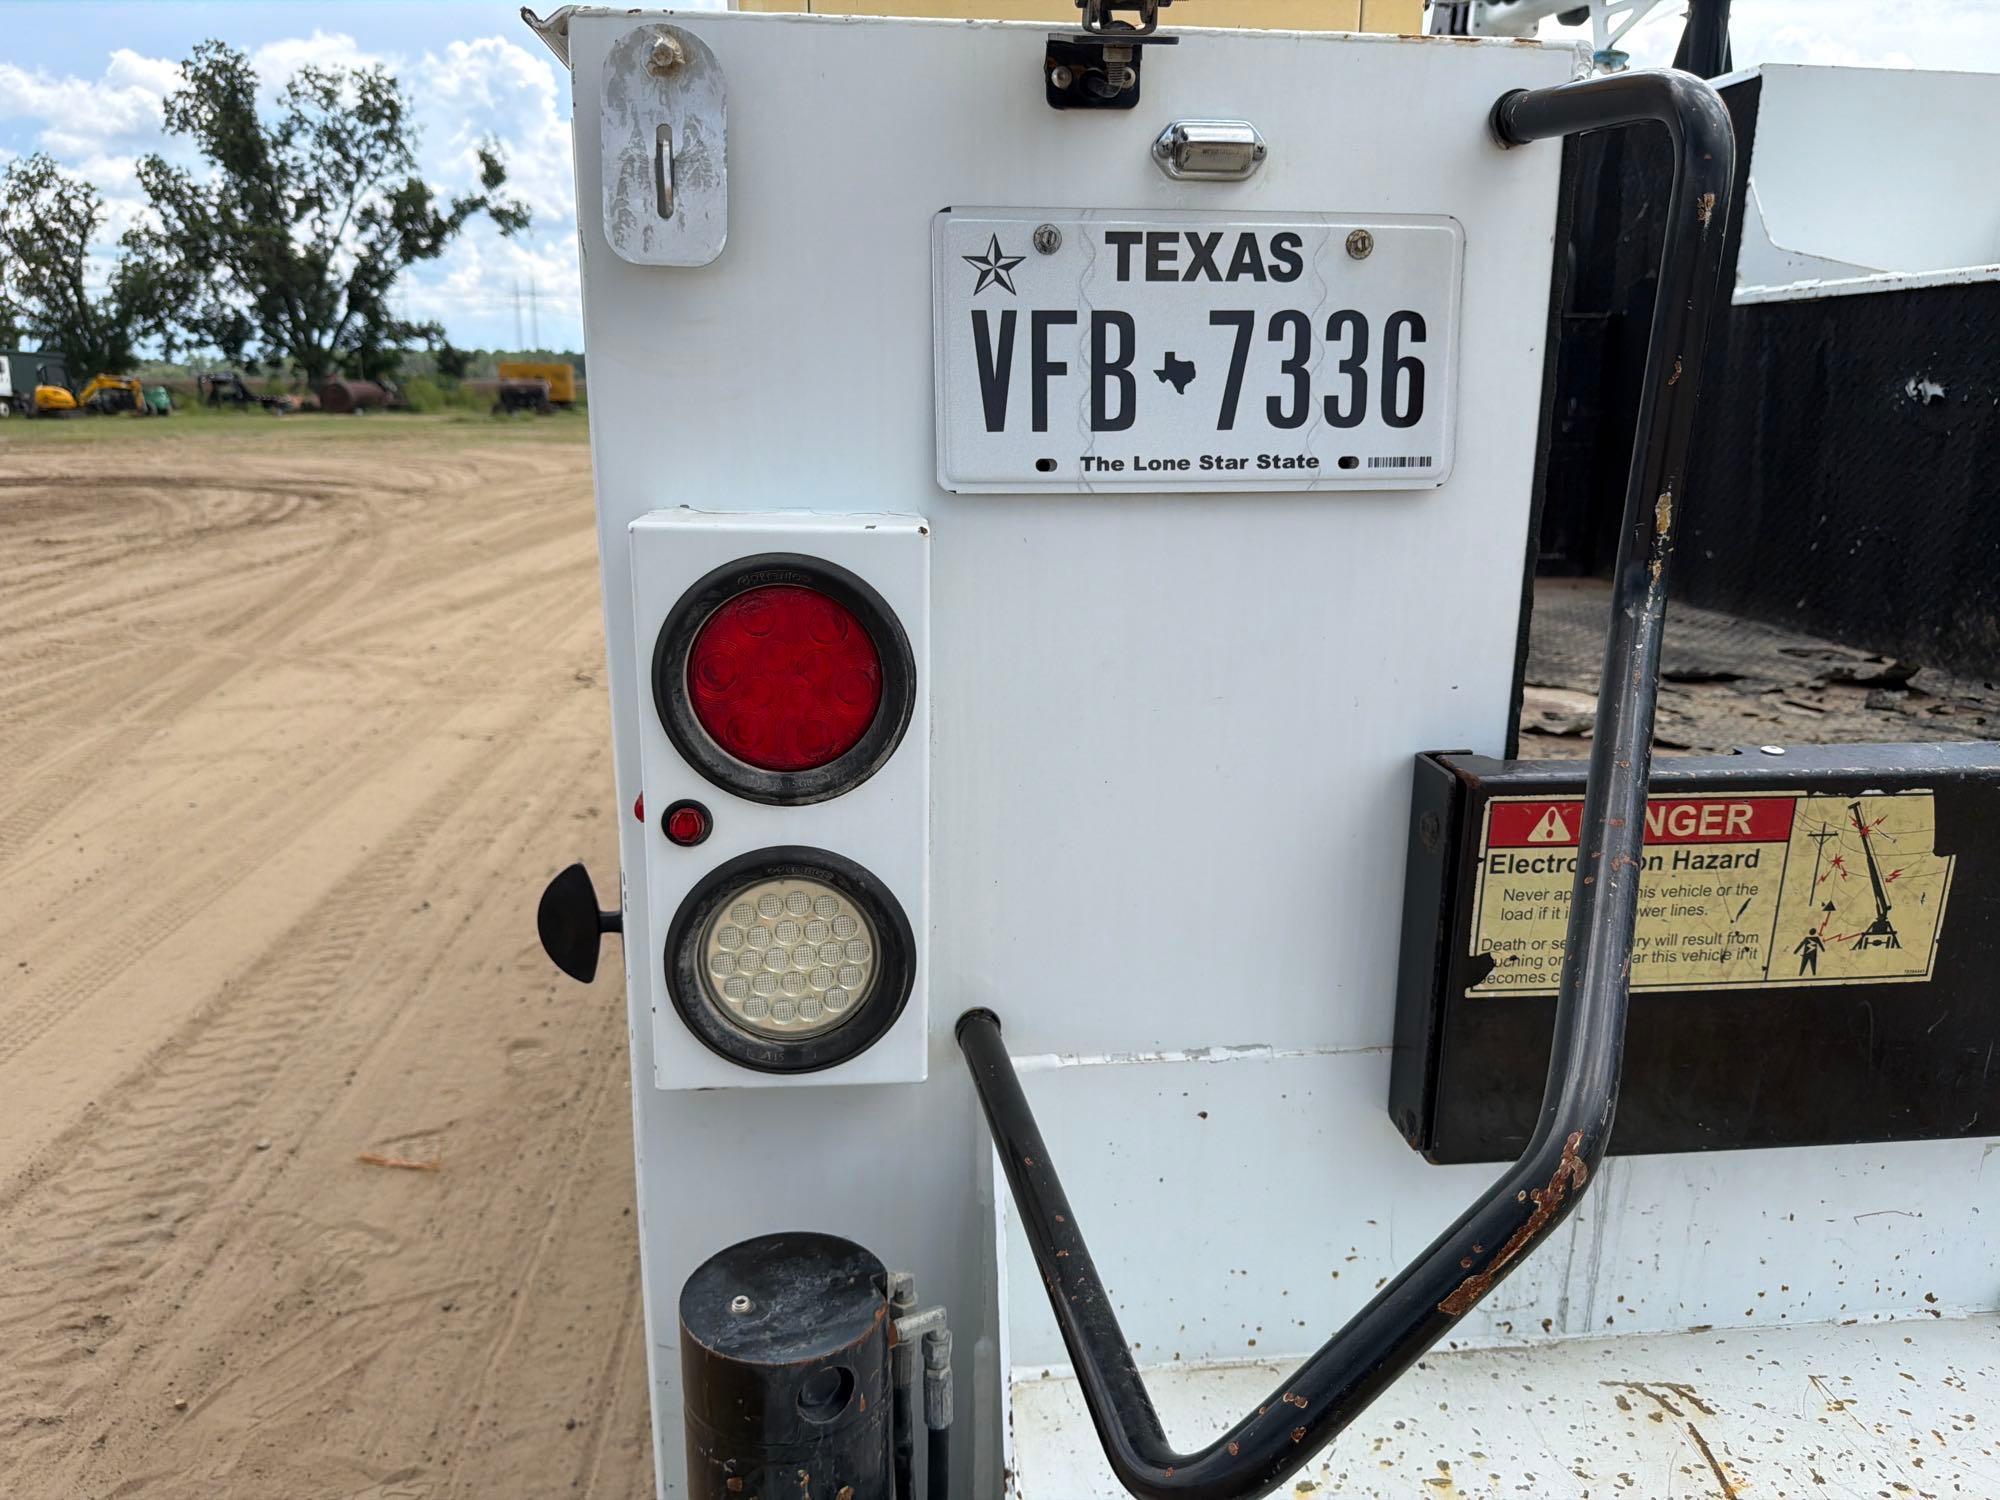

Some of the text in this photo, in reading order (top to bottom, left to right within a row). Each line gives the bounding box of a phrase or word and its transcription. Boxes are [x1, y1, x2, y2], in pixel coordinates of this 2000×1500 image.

[1105, 231, 1304, 283] TEXAS
[971, 309, 1427, 432] VFB 7336
[1080, 454, 1320, 471] The Lone Star State
[1672, 848, 1761, 871] Hazard
[1503, 888, 1550, 902] Never
[1637, 885, 1656, 898] his
[1661, 884, 1712, 898] vehicle
[1716, 886, 1733, 896] or
[1736, 883, 1759, 896] the
[1501, 907, 1534, 920] load
[1539, 907, 1549, 919] if
[1552, 907, 1560, 919] it
[1637, 906, 1668, 917] wer
[1670, 904, 1709, 916] lines.
[1481, 938, 1527, 951] Death
[1531, 939, 1548, 950] or
[1655, 934, 1678, 946] will
[1682, 932, 1723, 945] result
[1727, 931, 1759, 944] from
[1652, 950, 1677, 963] this
[1681, 948, 1732, 961] vehicle
[1736, 947, 1747, 960] if
[1749, 946, 1758, 959] it
